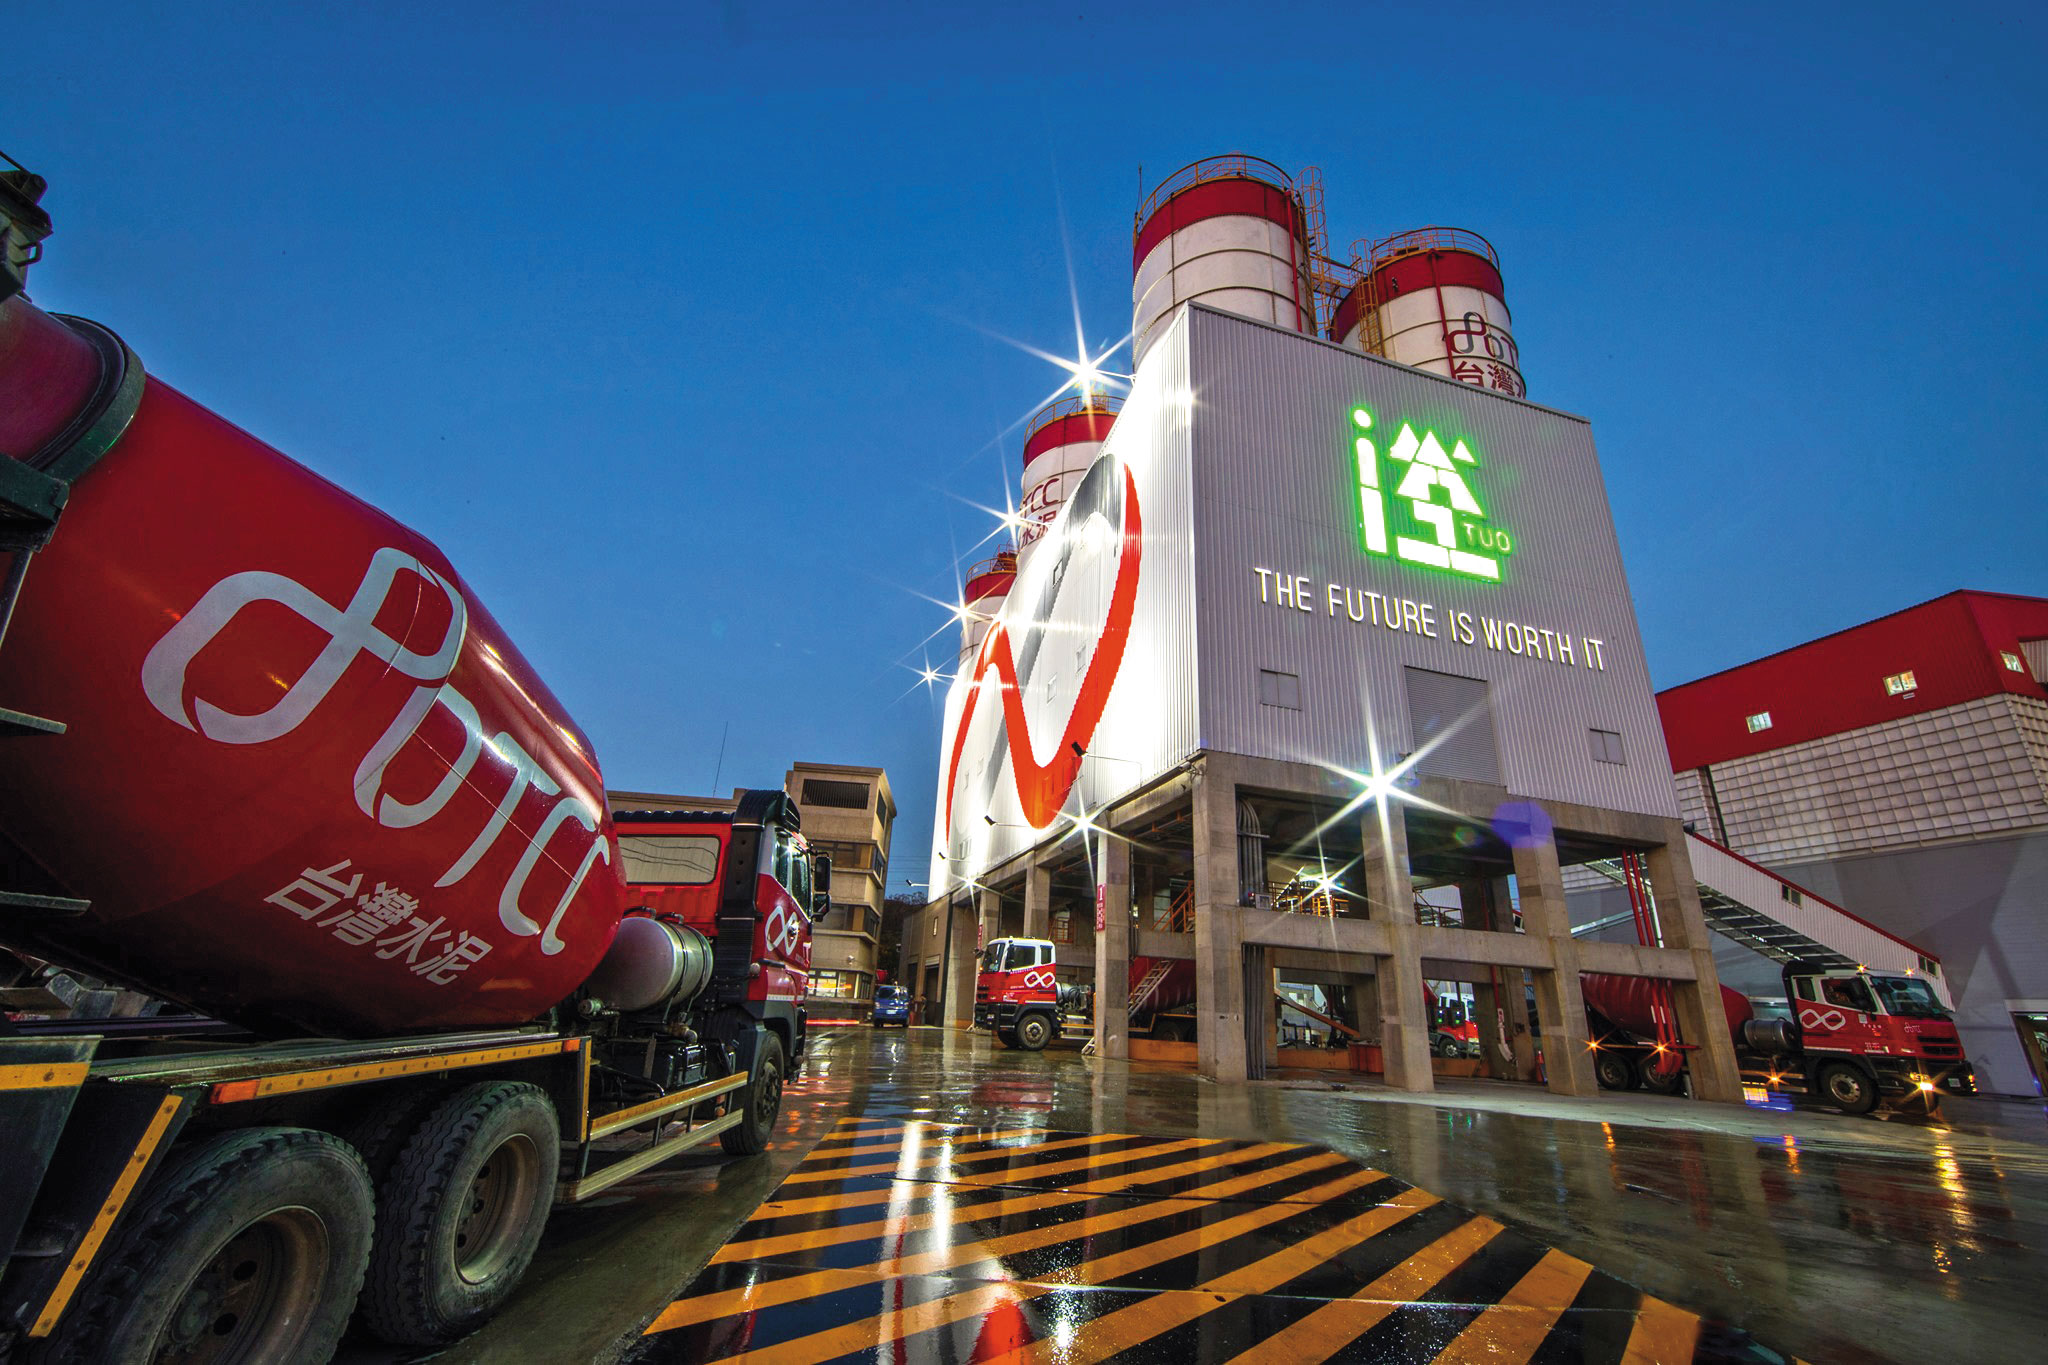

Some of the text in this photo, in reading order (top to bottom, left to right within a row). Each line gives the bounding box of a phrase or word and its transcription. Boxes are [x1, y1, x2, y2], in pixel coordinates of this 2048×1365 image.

[1461, 521, 1511, 553] TUO
[1254, 567, 1604, 671] THE FUTURE IS WORTH IT
[263, 858, 493, 986] 台灣水泥
